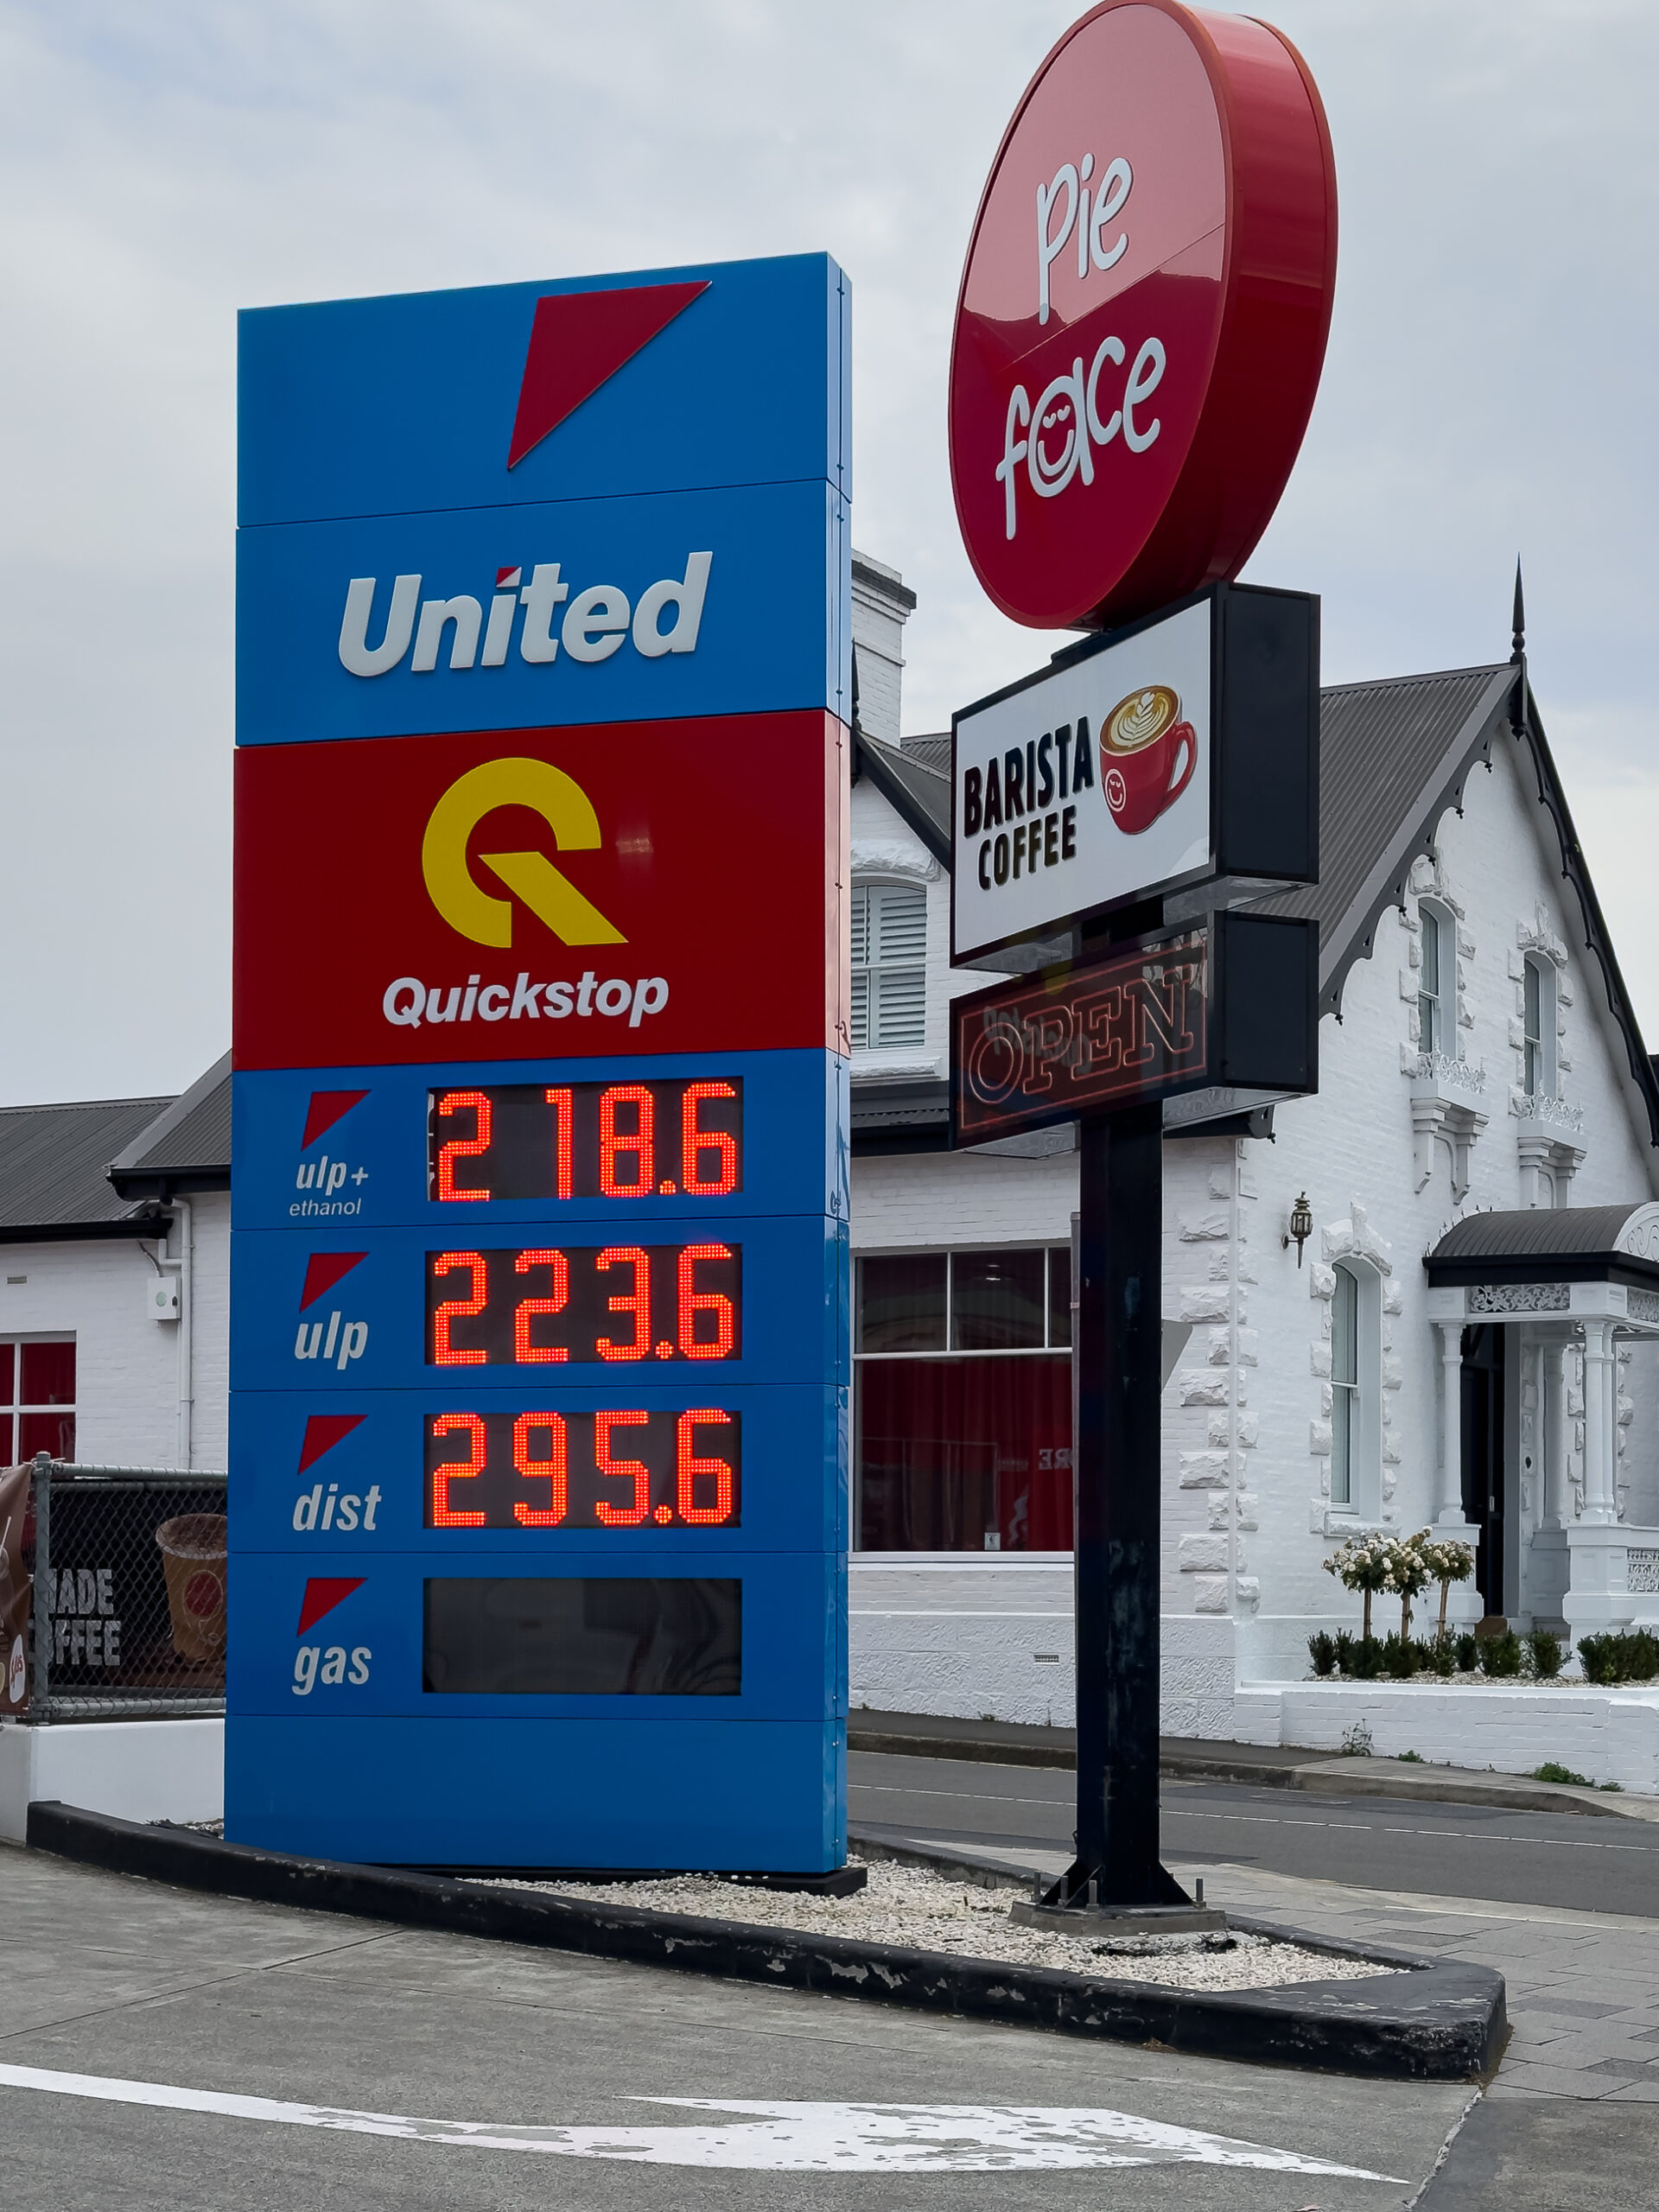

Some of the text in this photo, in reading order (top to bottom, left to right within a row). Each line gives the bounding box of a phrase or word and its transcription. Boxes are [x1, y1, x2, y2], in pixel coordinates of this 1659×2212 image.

[1037, 153, 1134, 325] pie
[995, 335, 1166, 541] face
[338, 550, 713, 677] United
[963, 715, 1096, 839] BARISTA
[977, 804, 1078, 892] COFFEE
[383, 971, 669, 1028] Quickstop
[969, 964, 1196, 1105] OPEN
[289, 1198, 361, 1217] ethanol
[295, 1311, 368, 1370] ulp
[434, 1243, 734, 1365] 223.6
[293, 1483, 382, 1531] dist
[432, 1408, 734, 1527] 295.6
[29, 1619, 121, 1666] FFEE
[293, 1645, 372, 1696] gas
